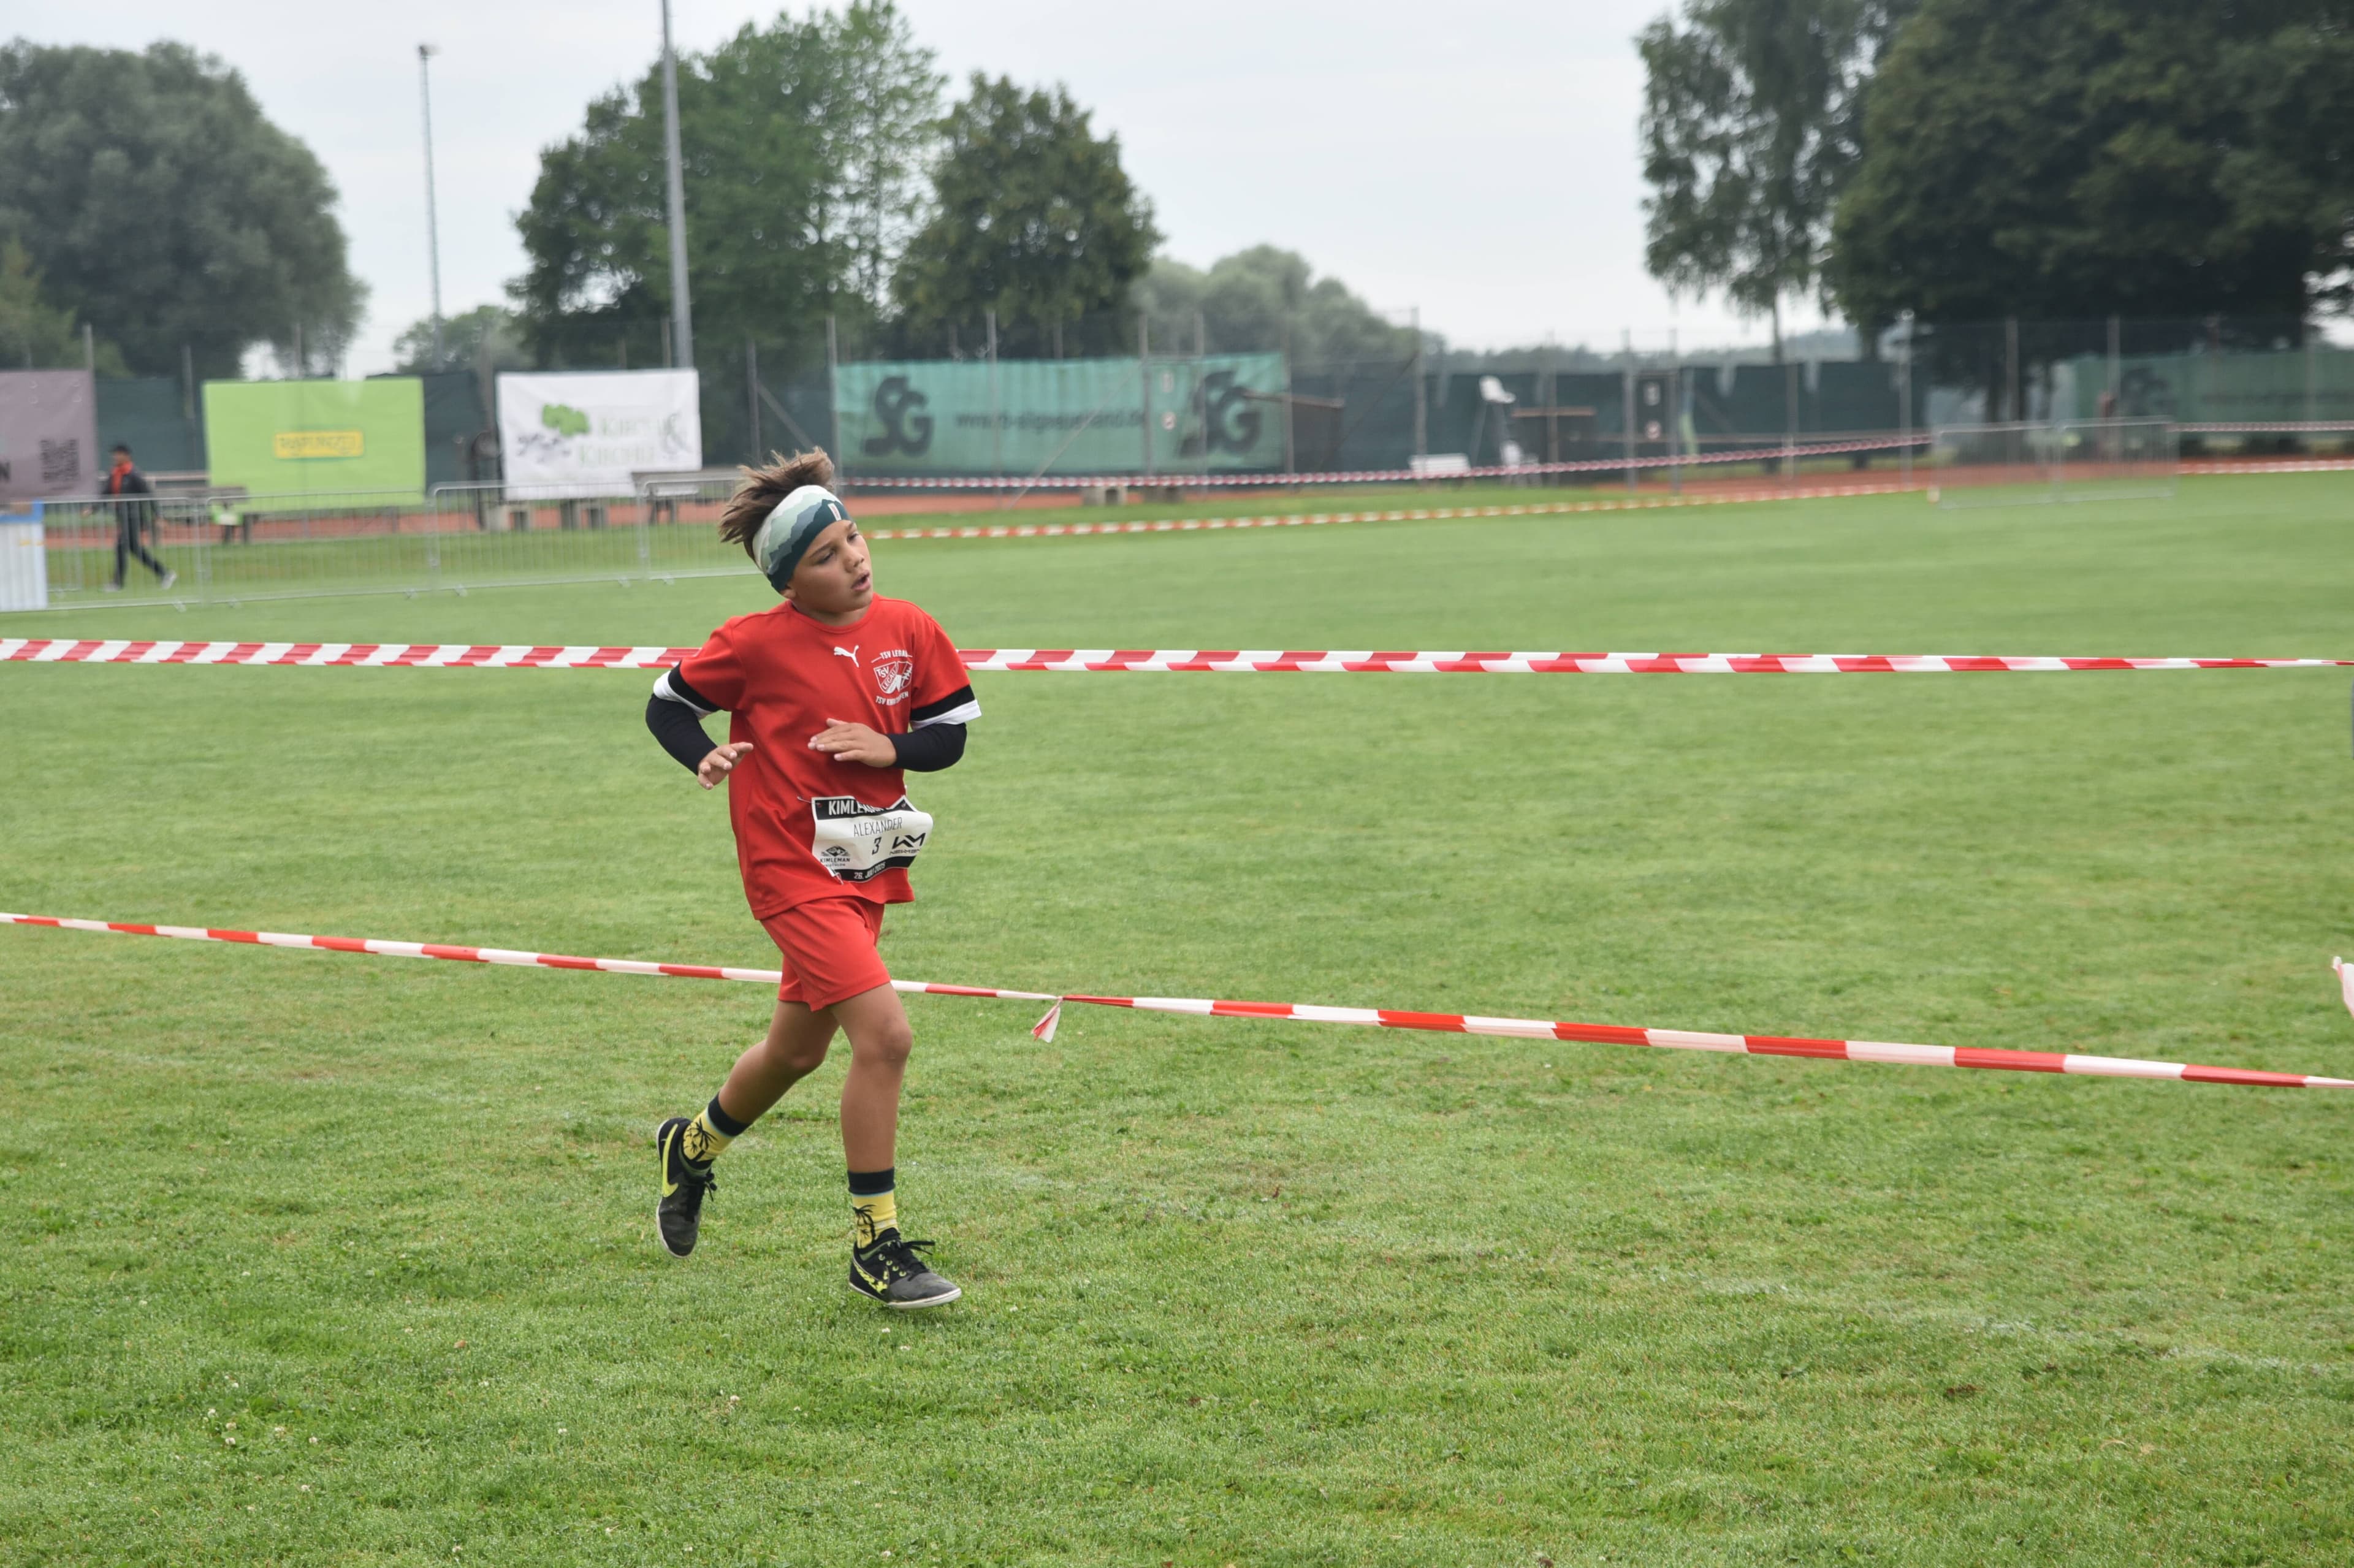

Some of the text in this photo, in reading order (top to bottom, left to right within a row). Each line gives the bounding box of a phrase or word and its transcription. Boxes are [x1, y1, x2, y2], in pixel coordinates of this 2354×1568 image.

[880, 651, 891, 660] TSV
[877, 666, 889, 679] TSV
[875, 696, 886, 705] TSV
[853, 816, 903, 837] ALEXANDER
[872, 837, 882, 854] 3
